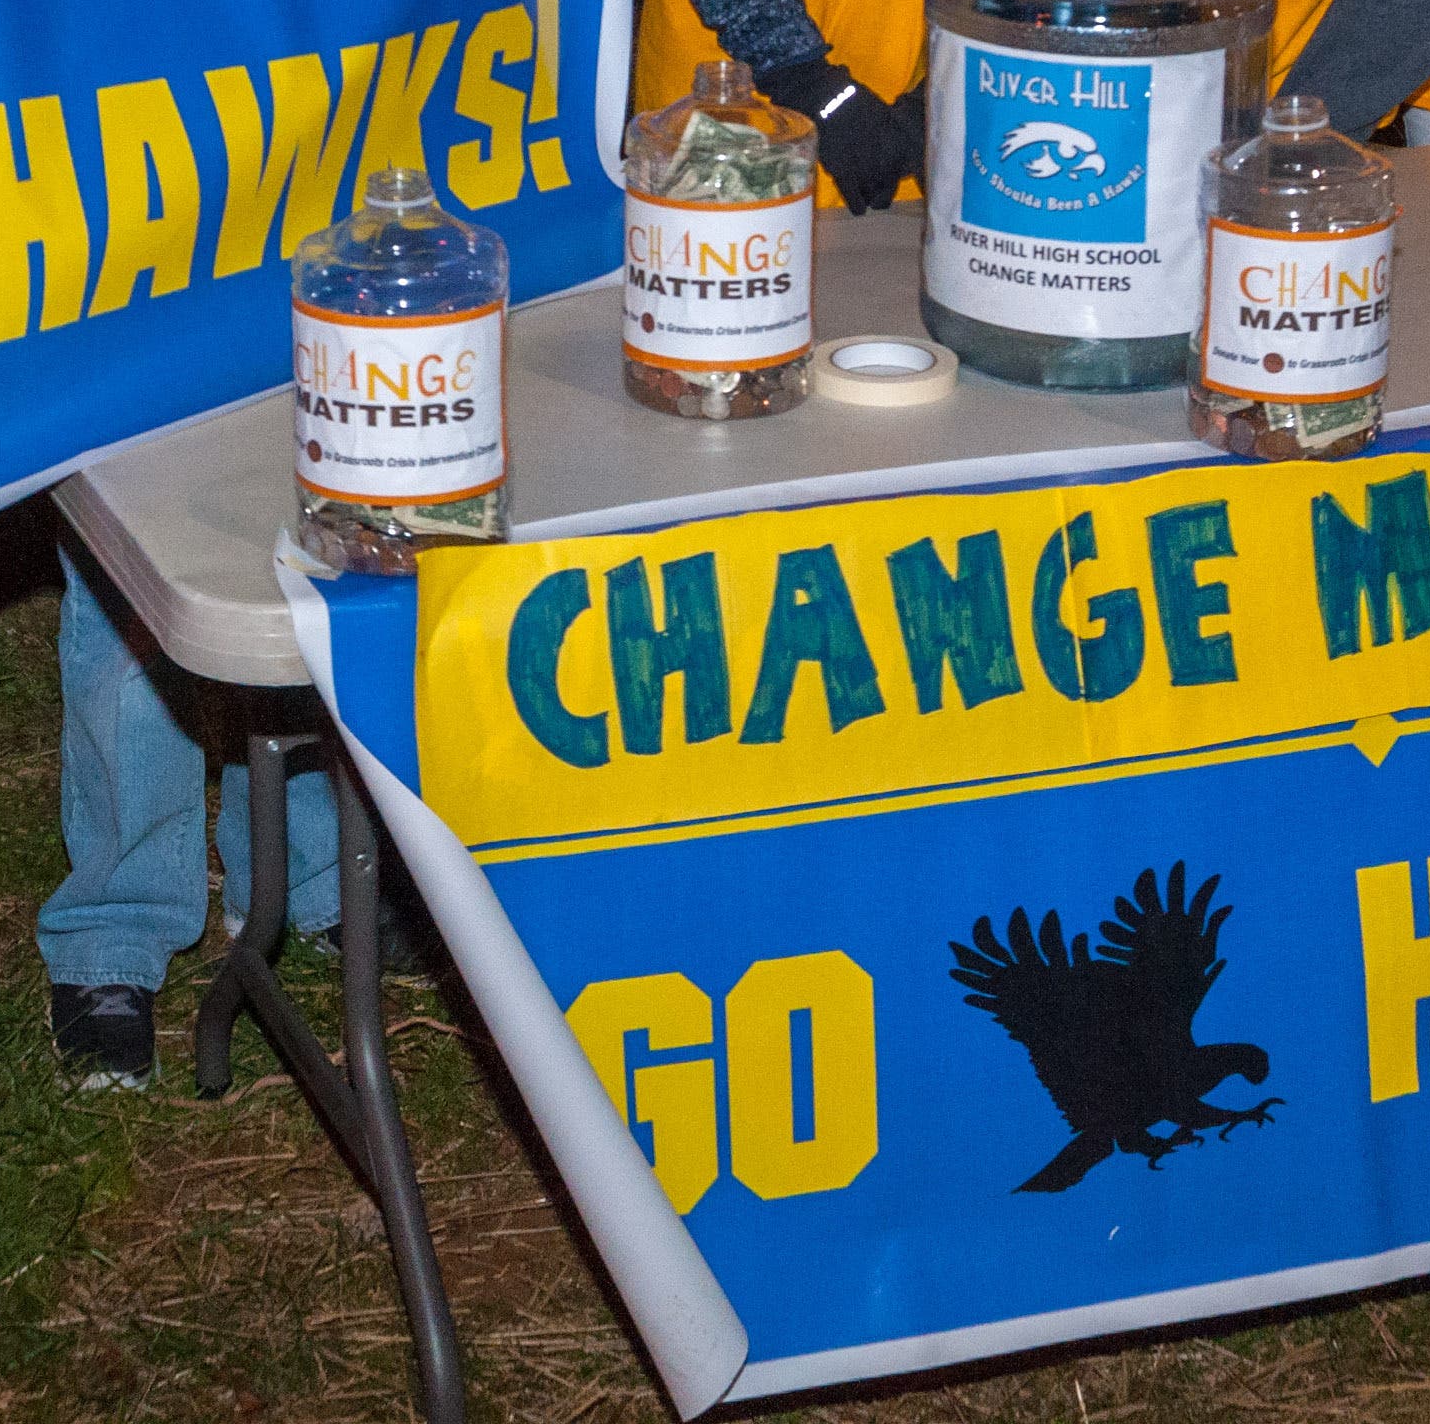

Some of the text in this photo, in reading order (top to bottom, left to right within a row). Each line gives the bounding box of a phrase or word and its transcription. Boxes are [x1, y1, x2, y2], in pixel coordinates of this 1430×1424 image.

[978, 58, 1130, 110] RIVER HILL
[1047, 196, 1084, 211] Been
[1088, 192, 1100, 208] A
[628, 225, 794, 276] CHANGE
[950, 224, 1162, 266] RIVER HILL HIGH SCHOOL
[629, 264, 792, 300] MATTERS
[968, 257, 1131, 293] CHANGE MATTERS
[1239, 255, 1388, 308] CHANG
[294, 340, 477, 401] CHANGE
[387, 456, 416, 468] Crisis
[506, 499, 1239, 769] CHANGE
[562, 949, 879, 1217] GO
